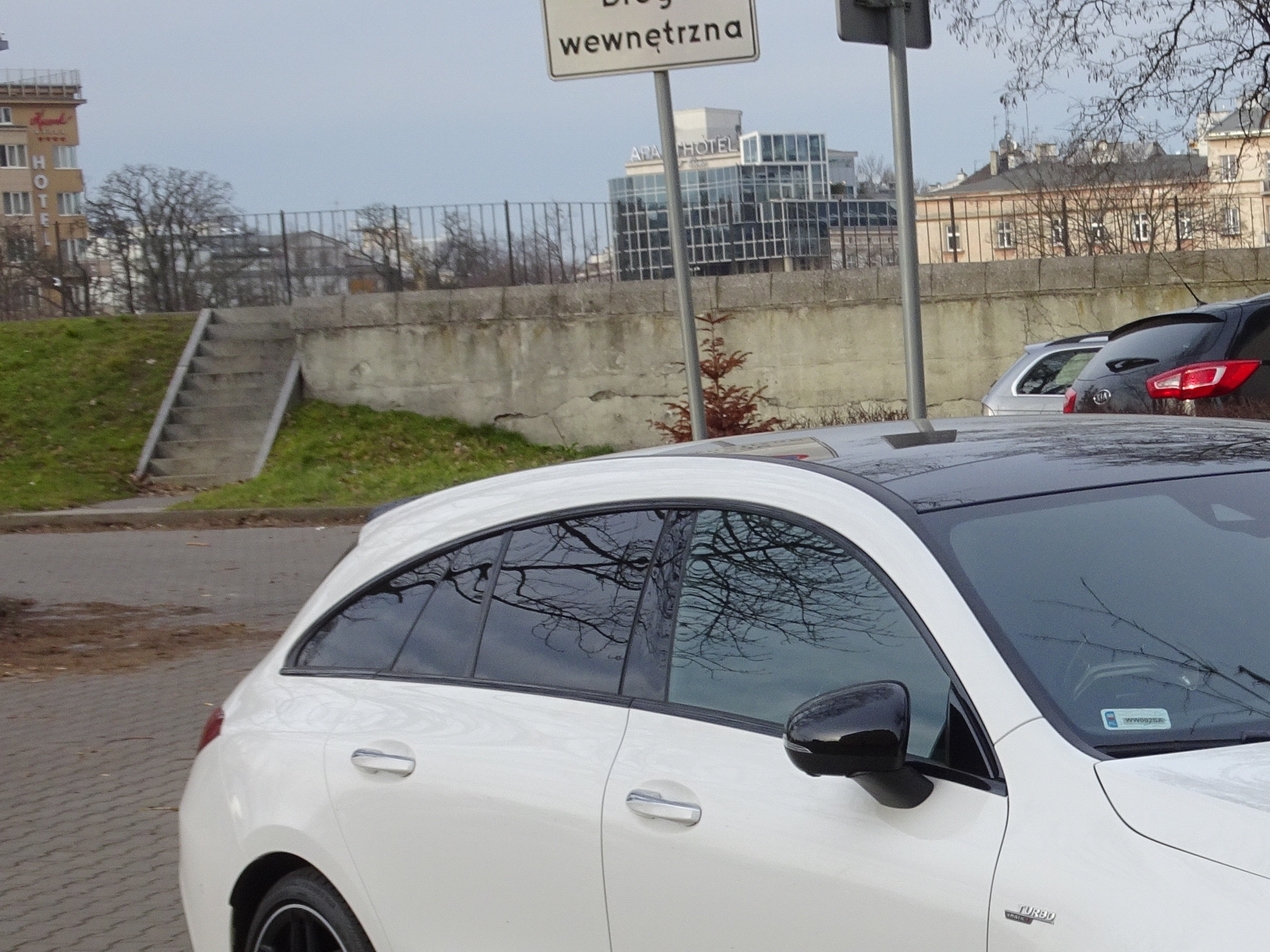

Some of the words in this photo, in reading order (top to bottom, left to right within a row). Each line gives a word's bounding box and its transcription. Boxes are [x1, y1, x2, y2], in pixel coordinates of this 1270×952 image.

[559, 19, 743, 54] wewnętrzna
[629, 136, 738, 161] APATHOTEL
[32, 154, 52, 246] HOTEL
[1019, 905, 1056, 921] TURBO
